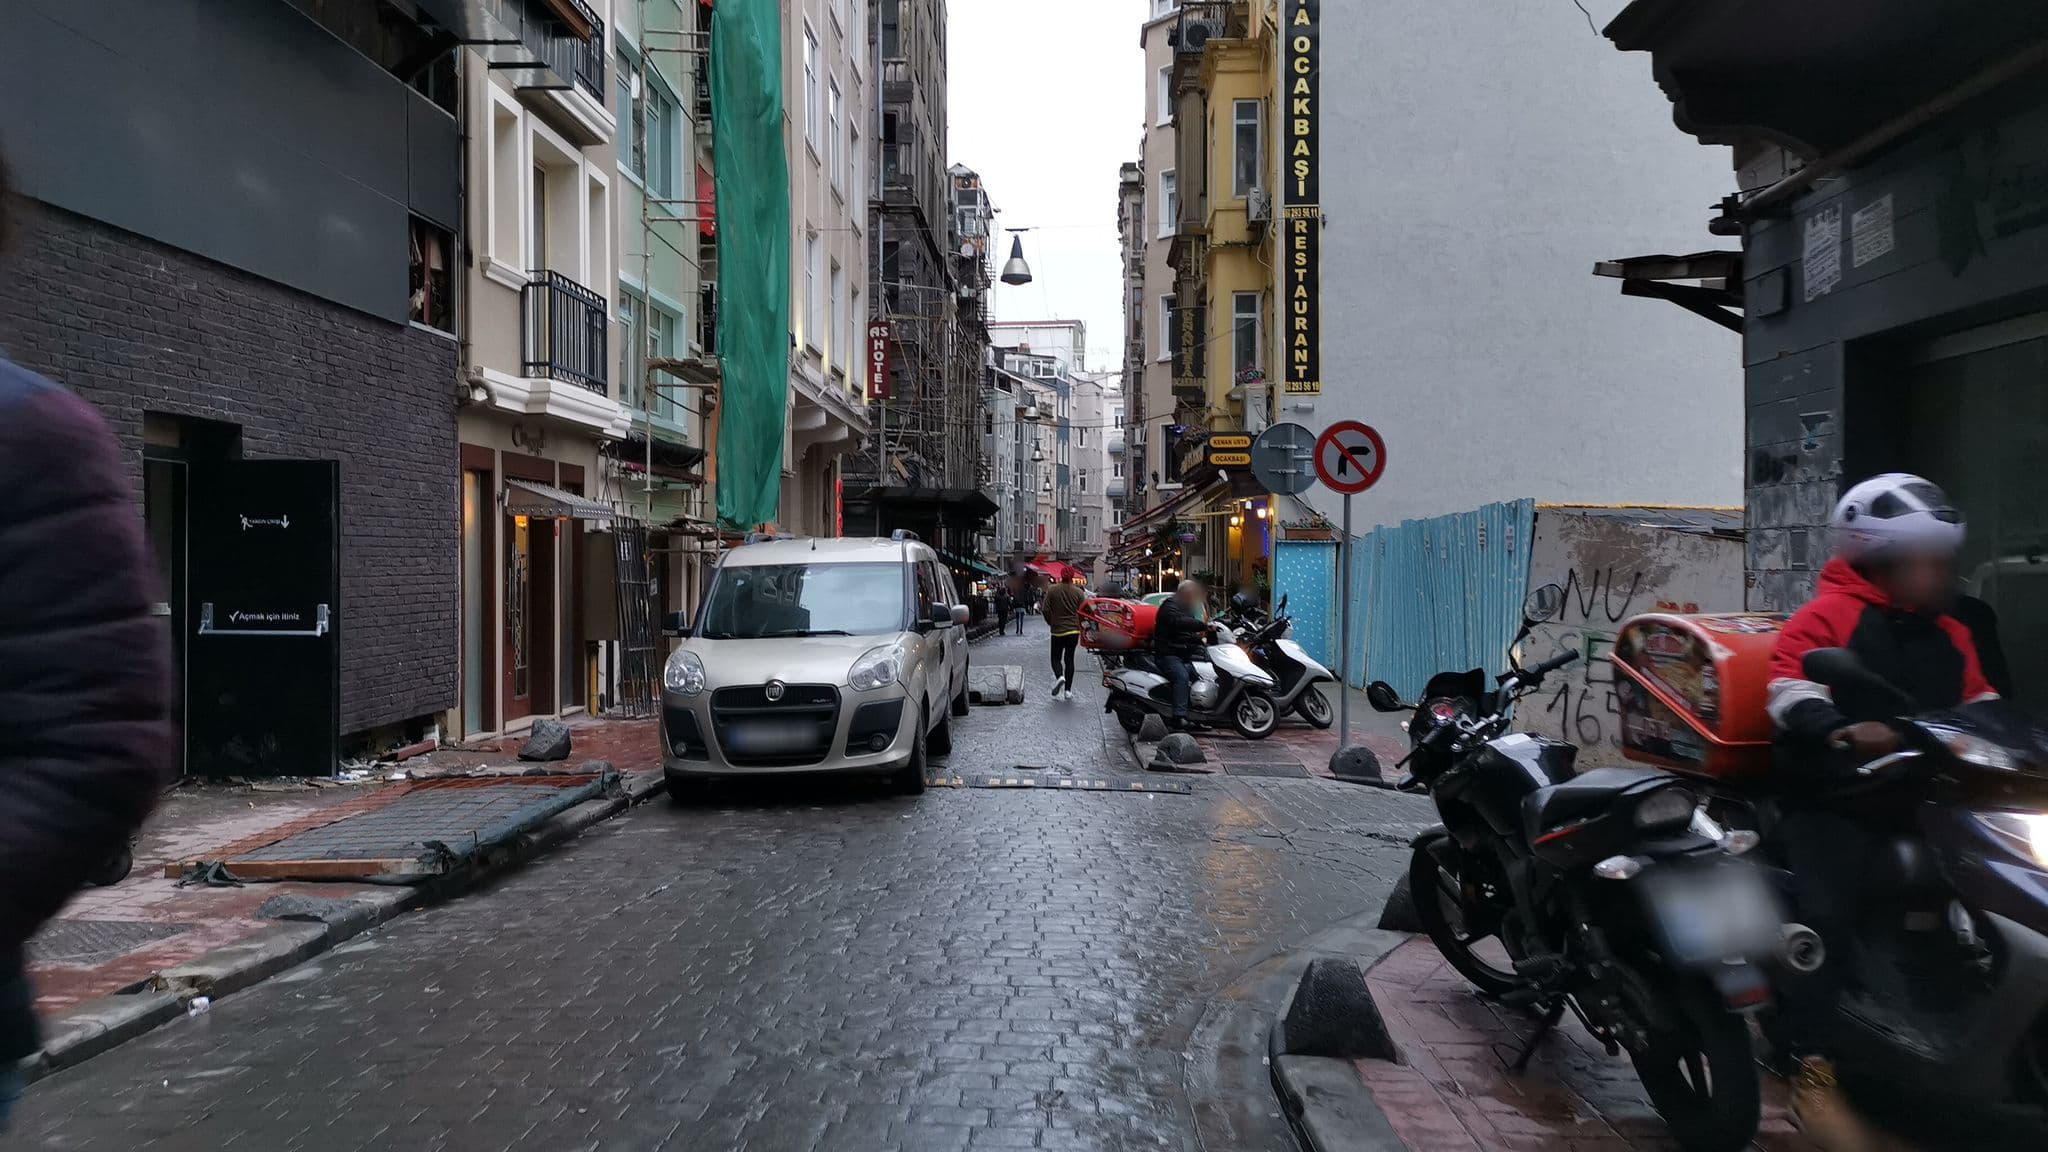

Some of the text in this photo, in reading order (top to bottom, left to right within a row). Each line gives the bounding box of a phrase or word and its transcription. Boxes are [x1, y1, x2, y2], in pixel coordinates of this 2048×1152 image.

[1294, 0, 1311, 26] A
[1295, 220, 1308, 379] RESTAURANT
[869, 326, 889, 338] AS
[873, 339, 885, 394] HOTEL
[1213, 438, 1232, 446] KENAN
[239, 612, 265, 622] Açmak
[266, 612, 280, 622] için
